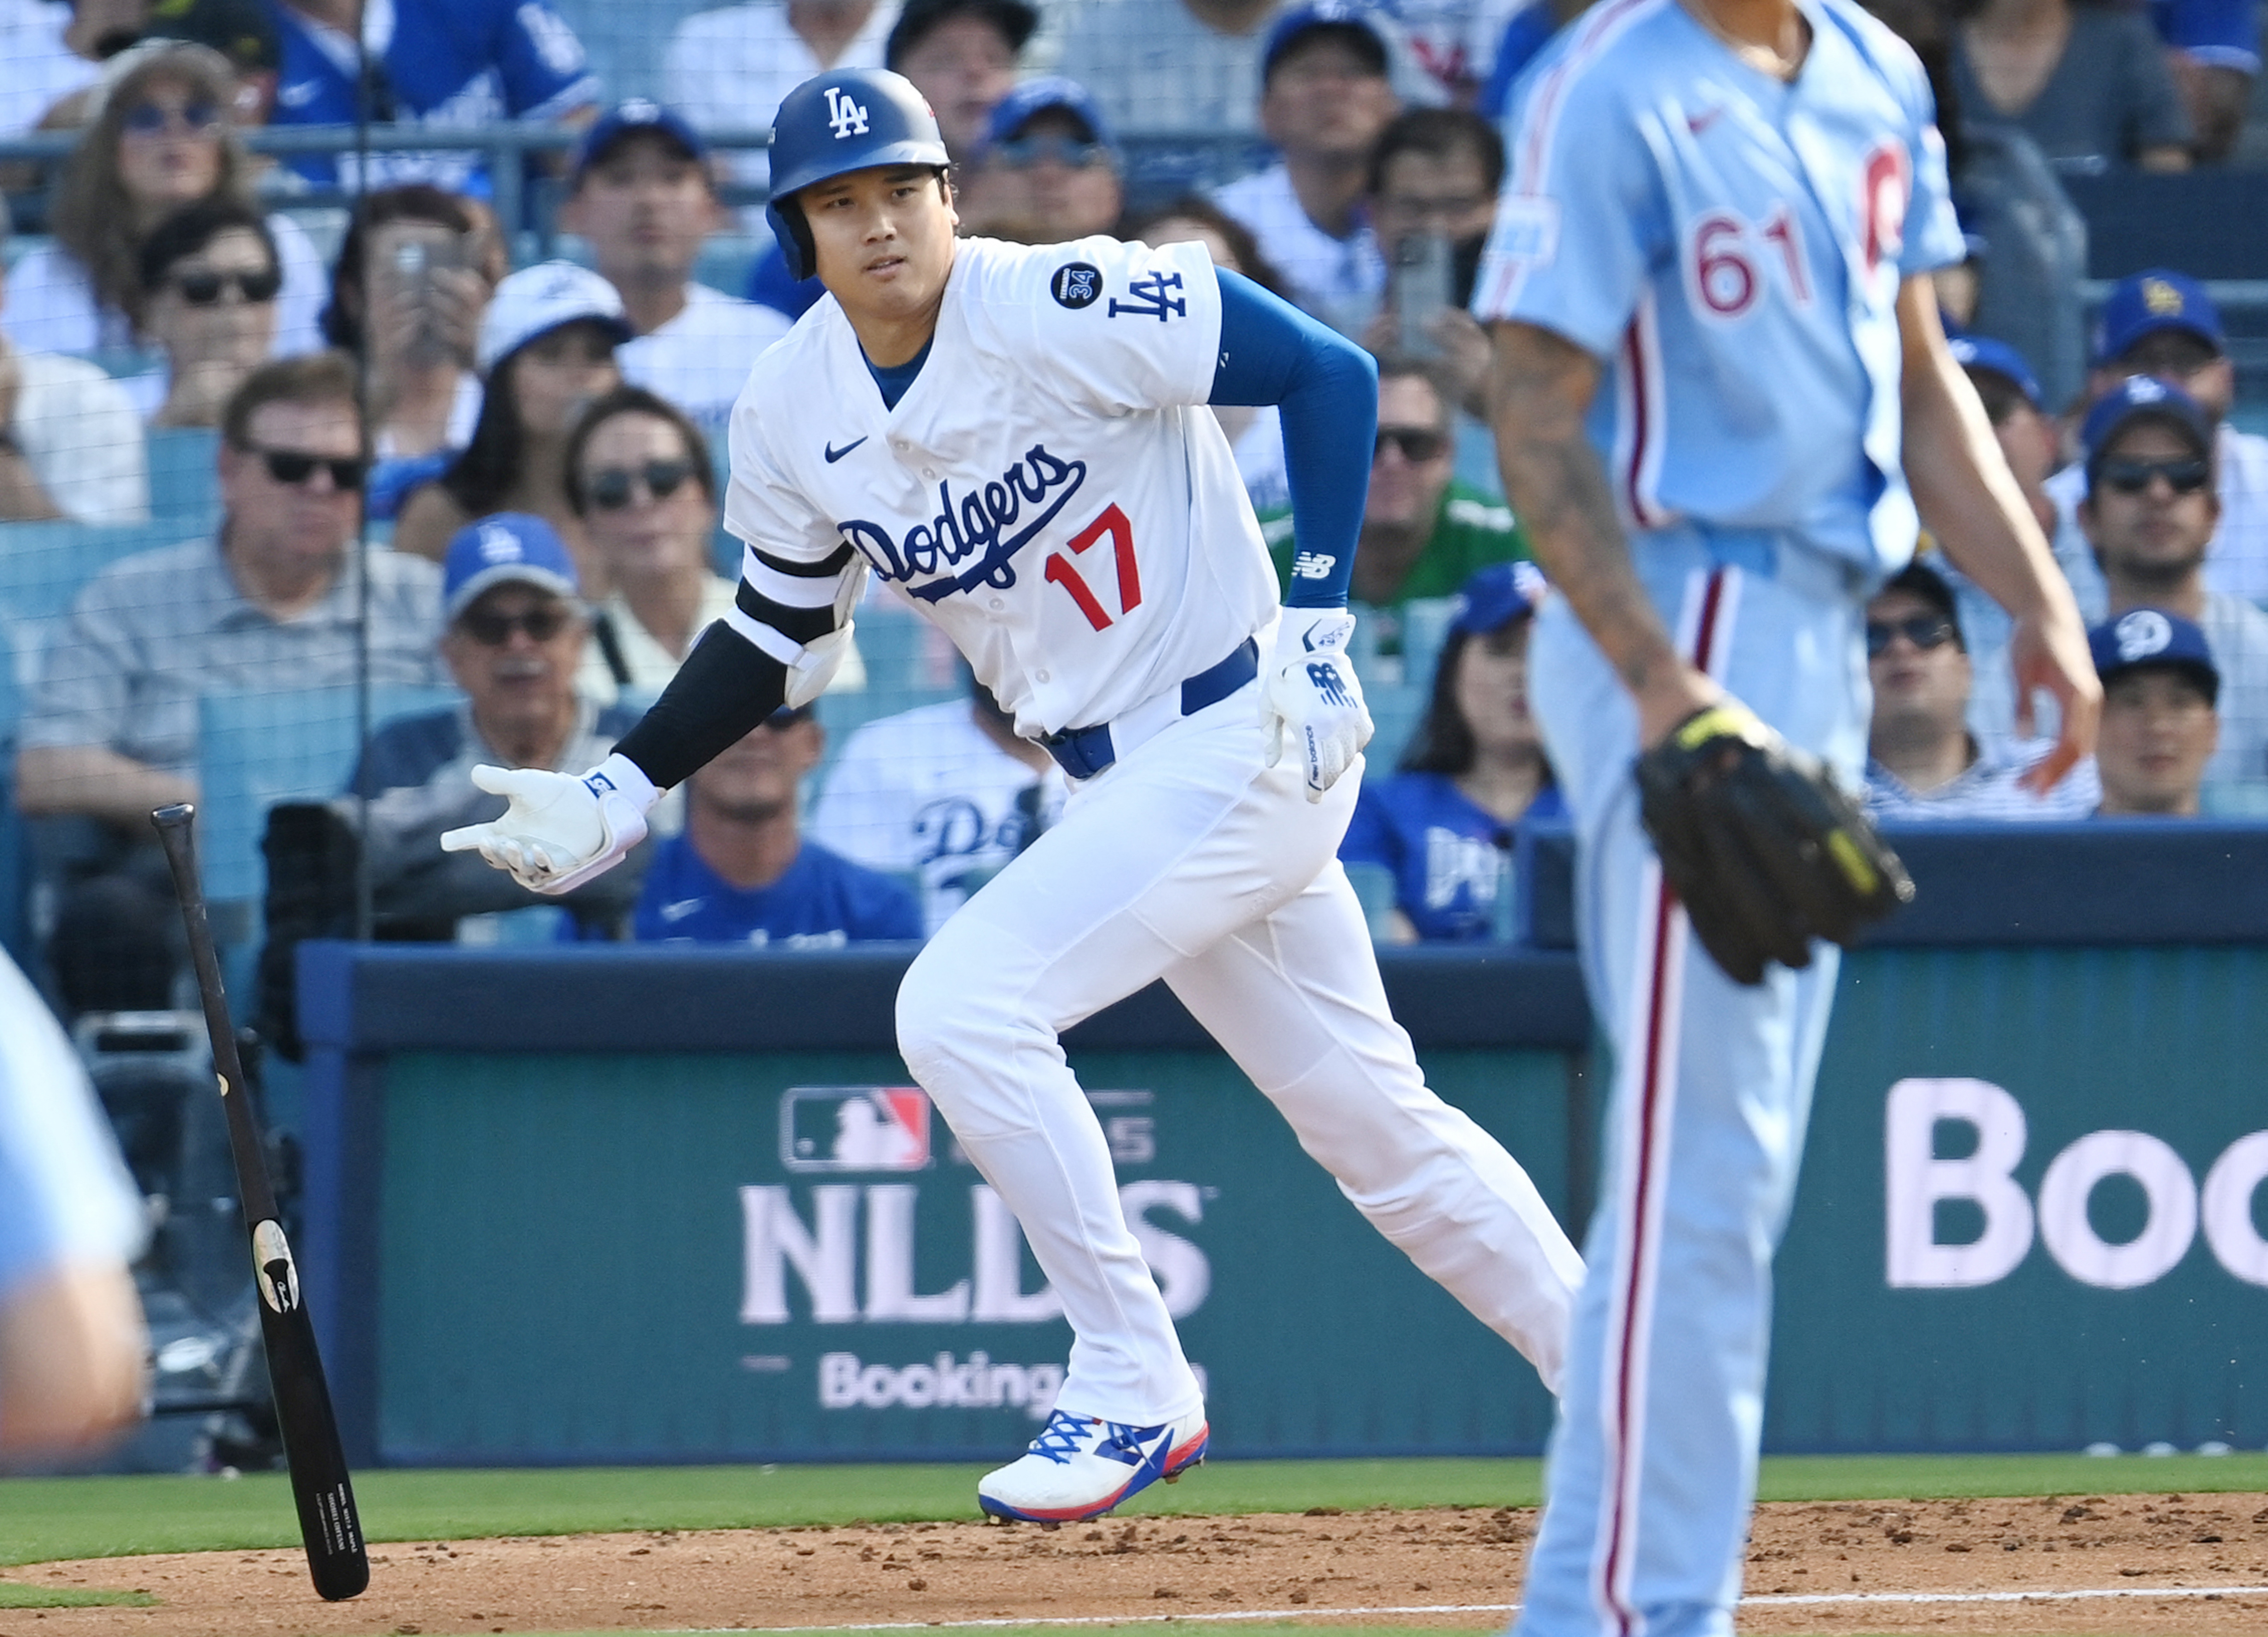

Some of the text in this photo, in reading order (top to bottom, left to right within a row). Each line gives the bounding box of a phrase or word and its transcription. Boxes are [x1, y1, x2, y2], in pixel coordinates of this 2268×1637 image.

[824, 87, 870, 139] LA
[1069, 270, 1095, 299] 34
[1688, 211, 1811, 317] 61
[1108, 269, 1187, 322] LA
[838, 444, 1086, 605] Dodgers
[1045, 502, 1142, 632] 17
[1305, 725, 1318, 762] balance
[818, 1350, 1208, 1422] Booking
